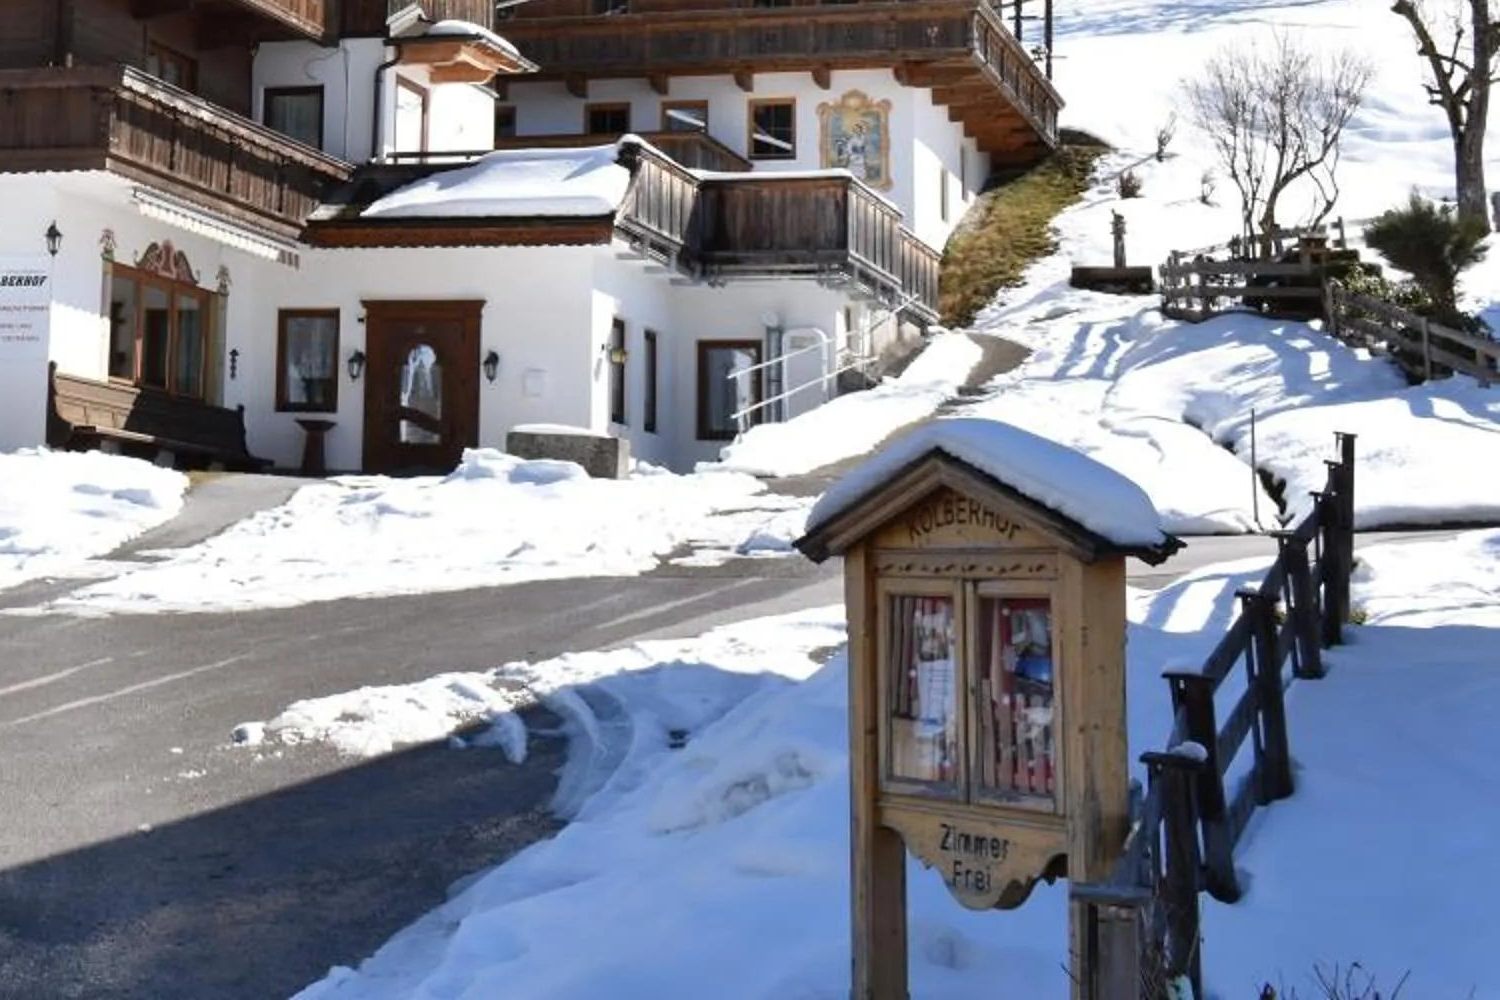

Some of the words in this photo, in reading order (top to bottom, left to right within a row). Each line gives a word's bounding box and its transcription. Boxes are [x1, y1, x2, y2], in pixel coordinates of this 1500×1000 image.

[908, 496, 1021, 543] KOLBERHOF
[940, 823, 1010, 860] Zimmer
[952, 860, 992, 894] Frei
